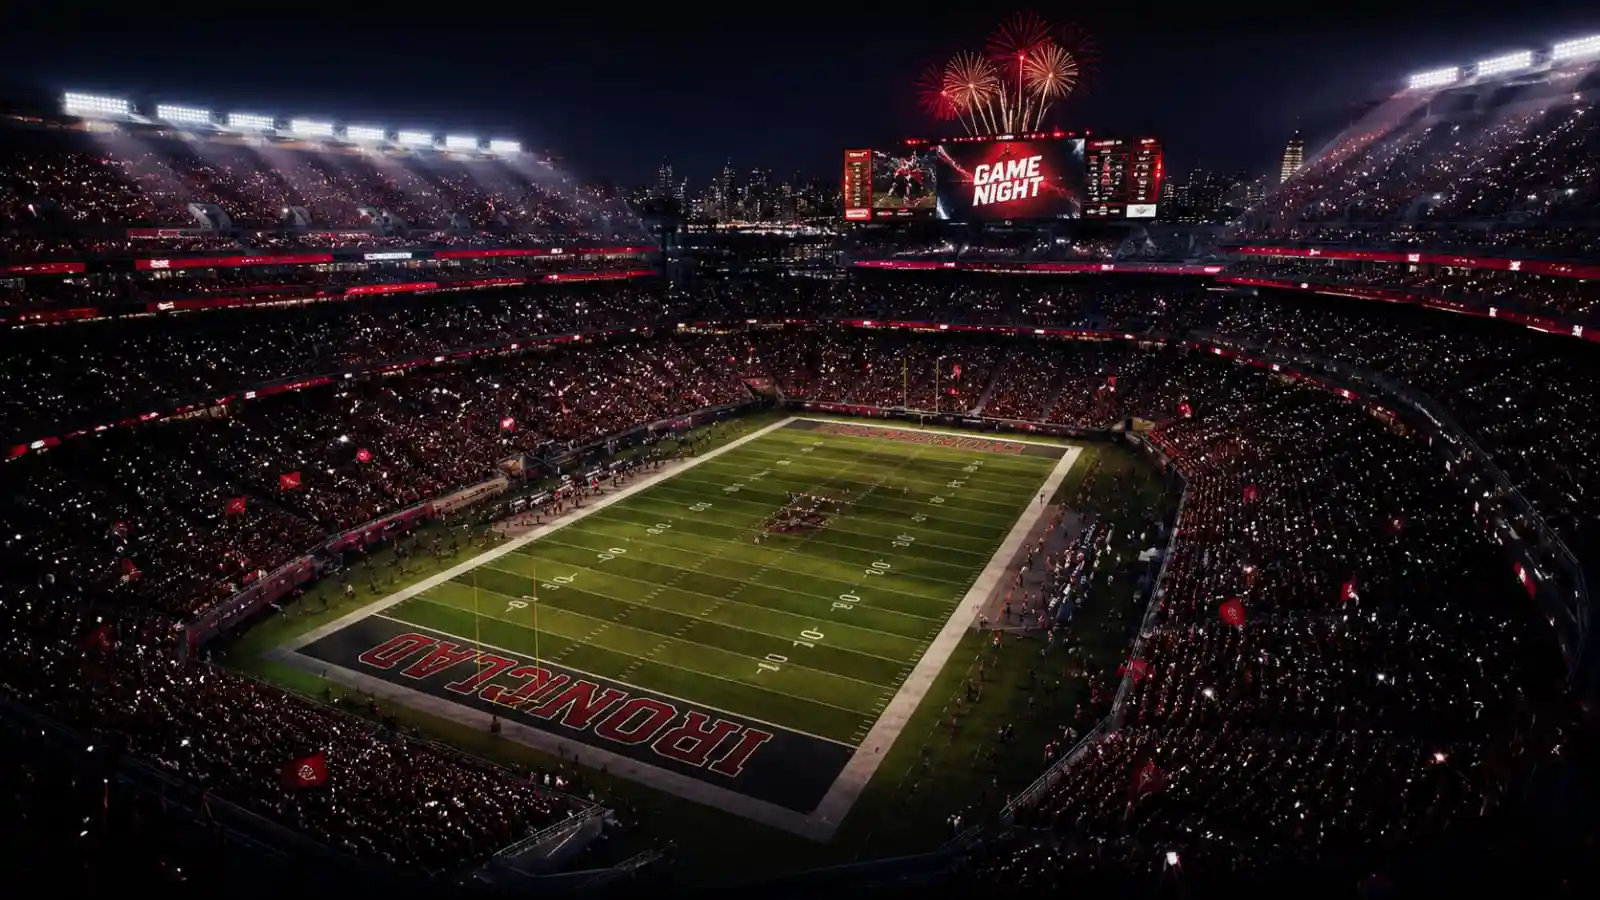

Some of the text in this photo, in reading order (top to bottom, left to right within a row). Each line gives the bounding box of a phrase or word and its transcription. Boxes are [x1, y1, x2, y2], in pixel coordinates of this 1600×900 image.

[973, 155, 1043, 186] GAME
[972, 175, 1044, 206] NIGHT
[358, 632, 774, 778] IRONCLAD
